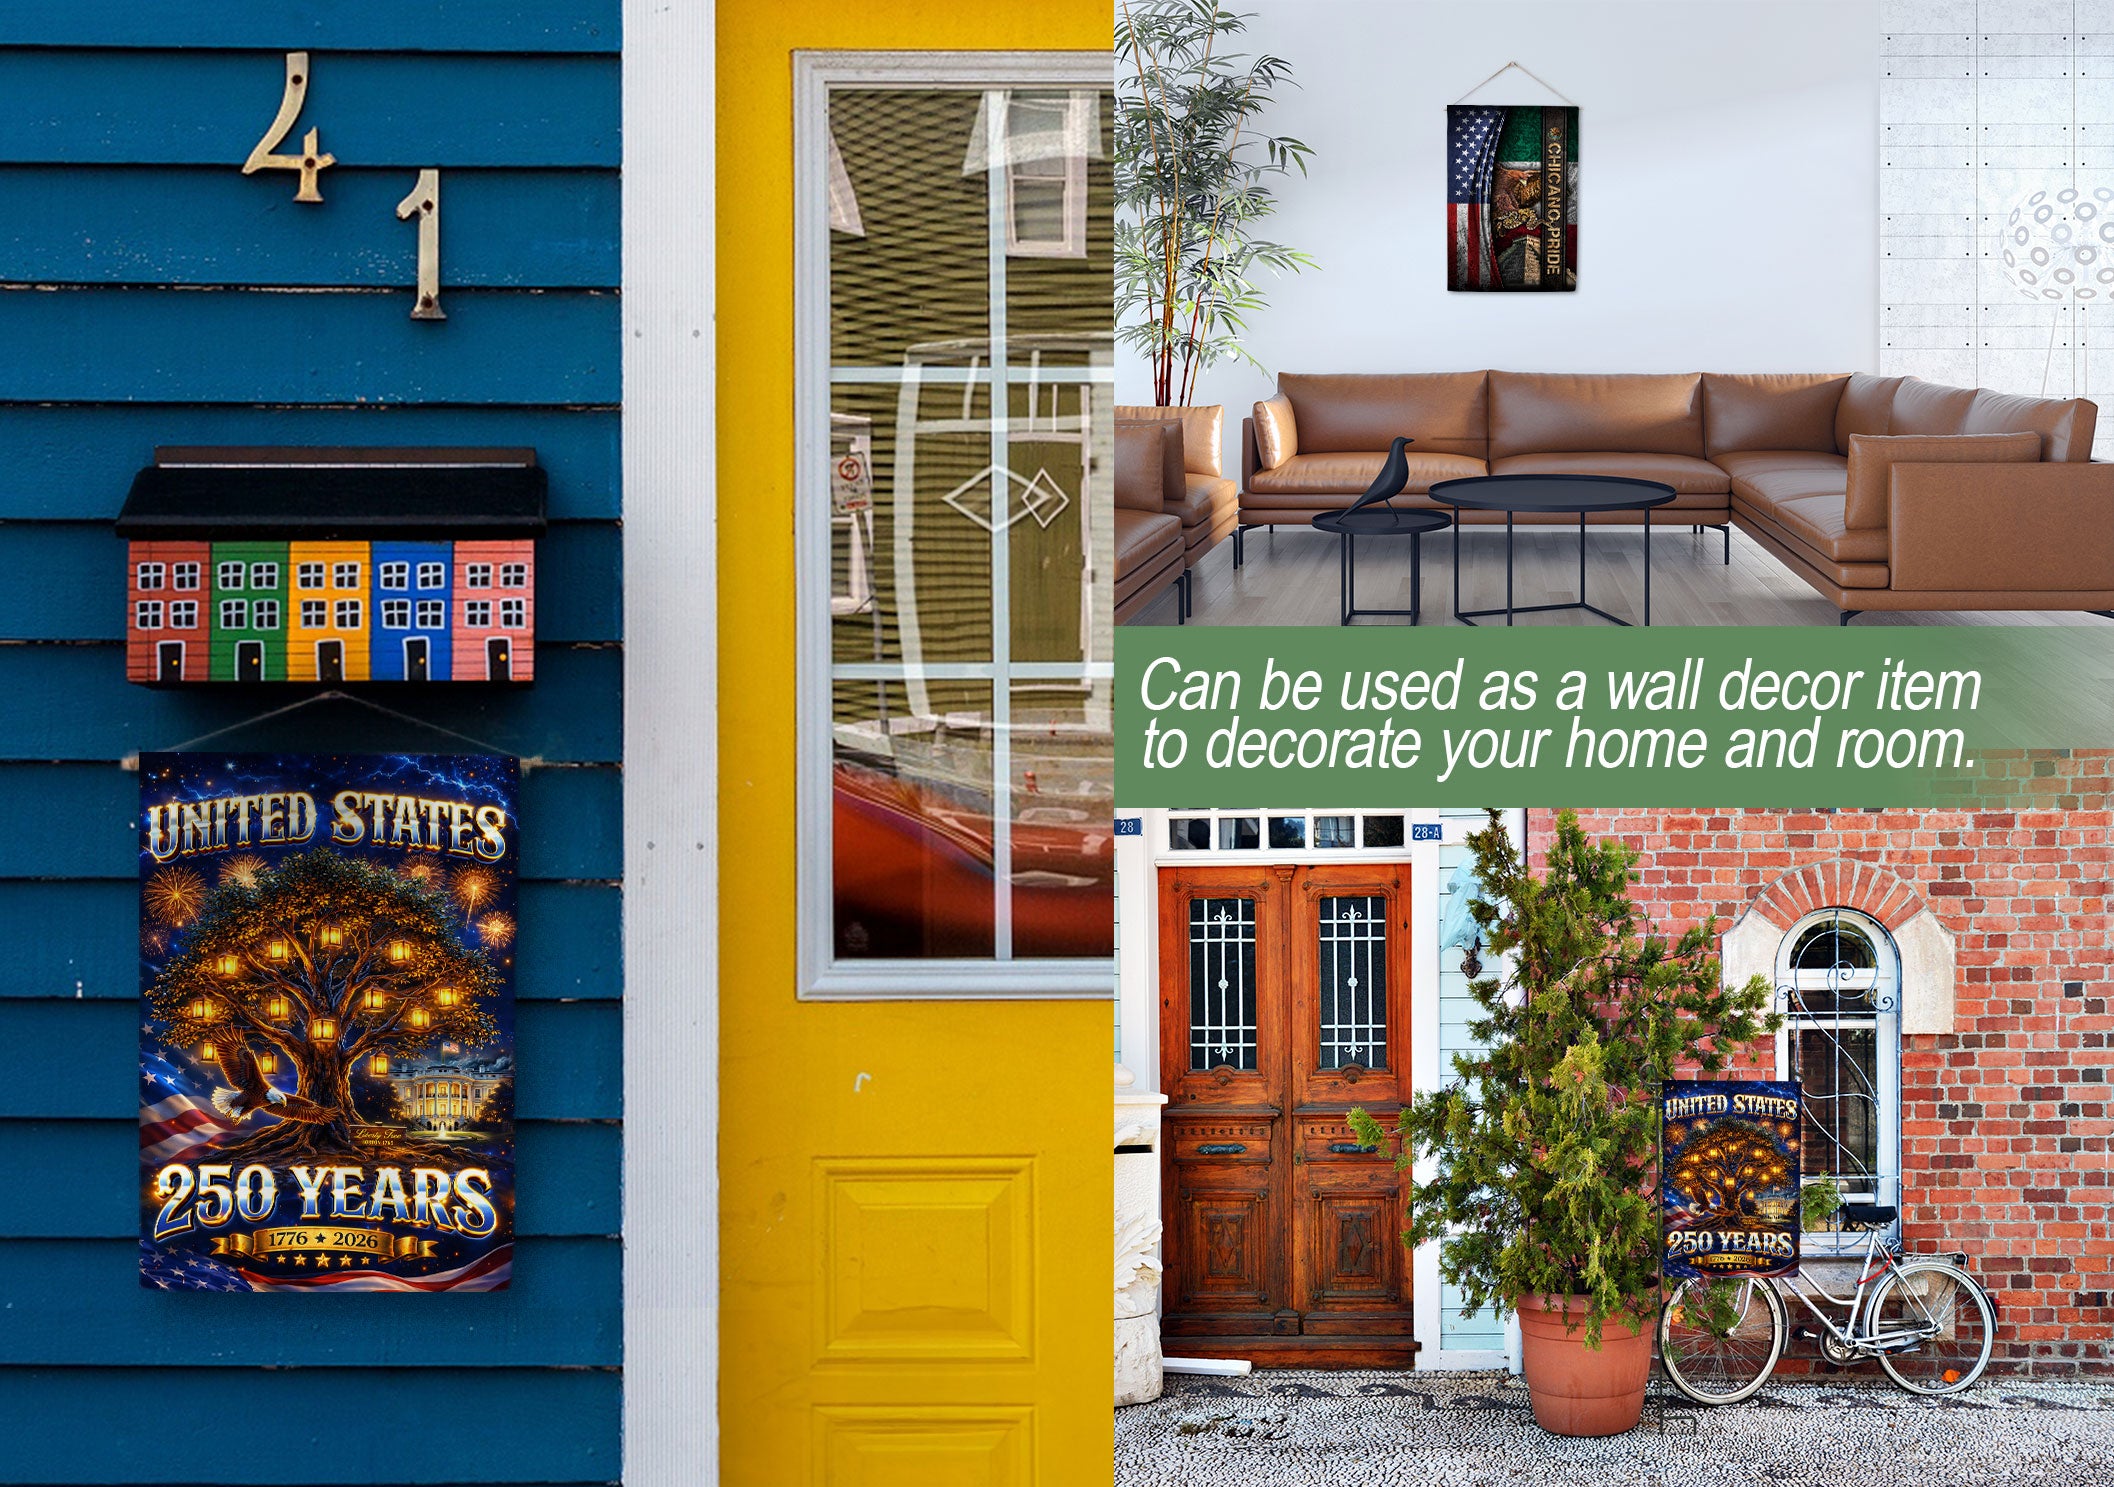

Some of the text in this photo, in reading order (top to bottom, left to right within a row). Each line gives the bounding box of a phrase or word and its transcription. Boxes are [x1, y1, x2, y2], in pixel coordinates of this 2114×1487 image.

[1546, 143, 1562, 275] CHICANO PRIDE
[147, 790, 507, 863] UNITED STATES
[1120, 821, 1134, 833] 28
[1414, 826, 1440, 839] 28-A
[1665, 1094, 1798, 1121] UNITED STATES
[354, 1128, 402, 1140] Liberty Tree
[154, 1163, 498, 1241] 250 YEARS
[269, 1231, 379, 1249] 1776 2026
[1667, 1231, 1795, 1259] 250 YEARS
